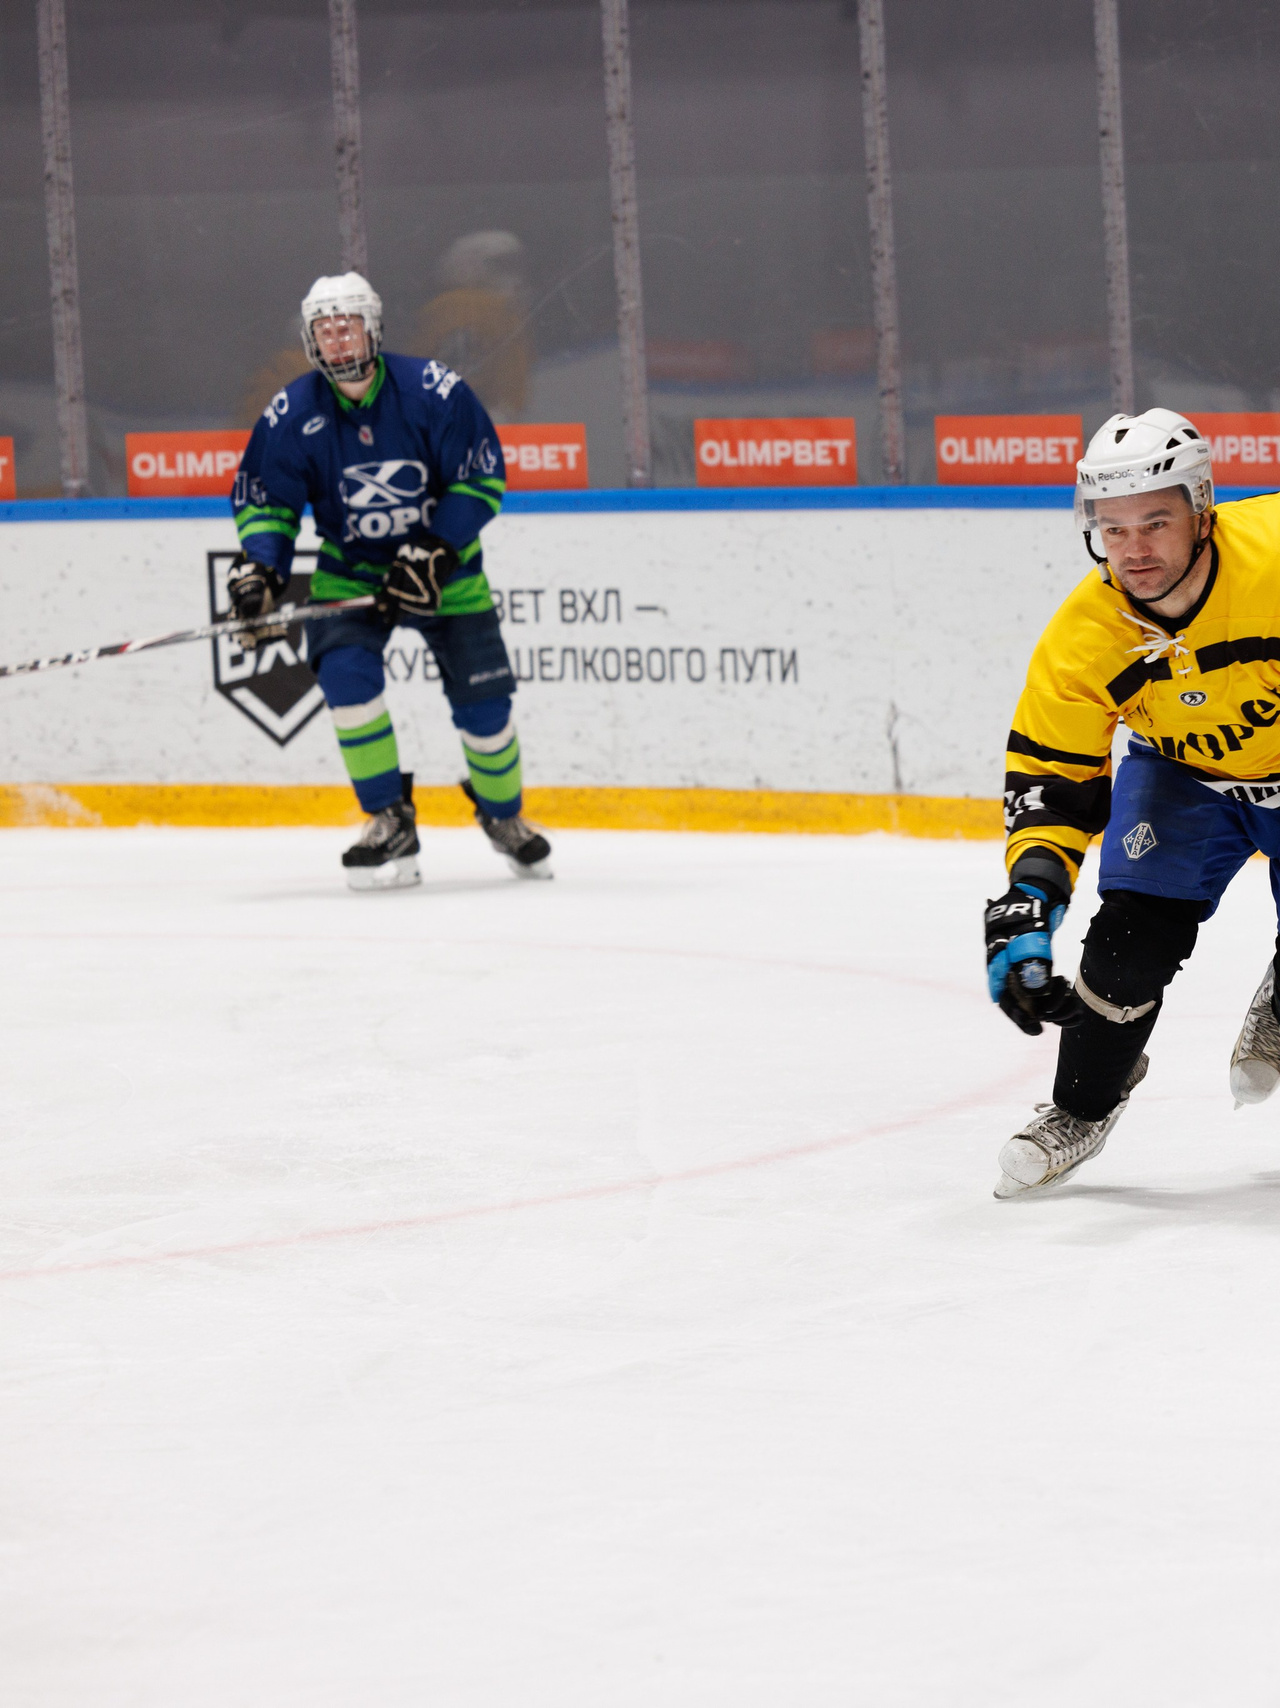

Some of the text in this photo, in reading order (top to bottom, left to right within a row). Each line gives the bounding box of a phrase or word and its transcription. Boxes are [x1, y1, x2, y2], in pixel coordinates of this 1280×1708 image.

[700, 439, 851, 466] OLIMPBET
[940, 437, 1077, 464] OLIMPBET
[132, 451, 244, 478] OLIMP
[1098, 469, 1135, 482] Reebok
[560, 588, 622, 624] ВХЛ
[720, 647, 799, 685] ПУТИ
